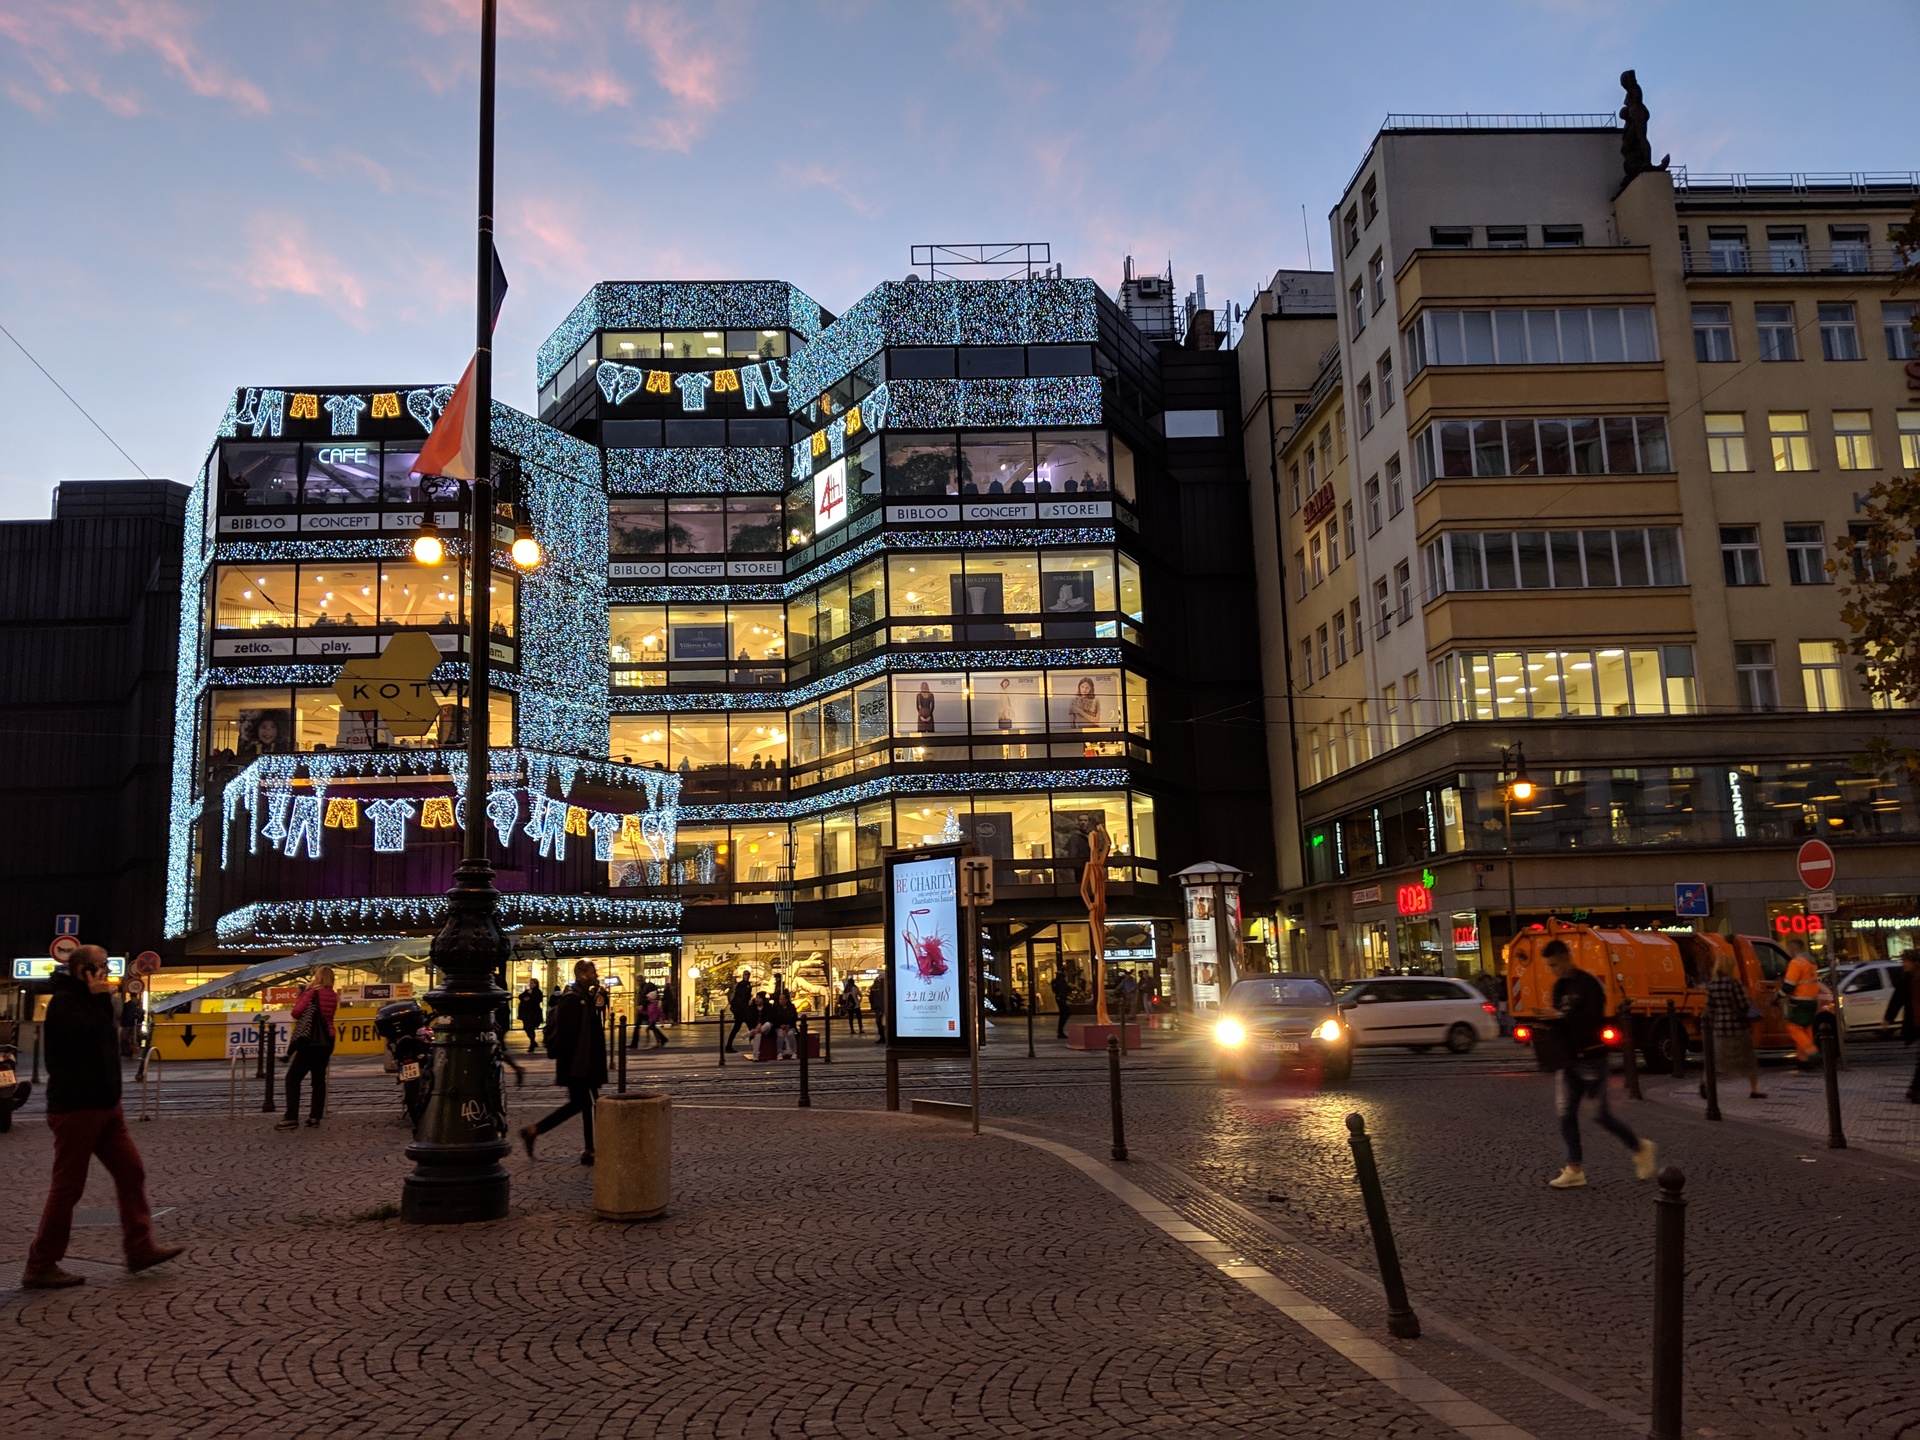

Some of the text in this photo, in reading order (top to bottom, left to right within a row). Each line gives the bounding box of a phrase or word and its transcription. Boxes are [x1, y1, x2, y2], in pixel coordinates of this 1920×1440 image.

[318, 448, 367, 464] CAFE
[897, 504, 1099, 519] BIBLOO CONCEPT STORE!
[231, 514, 446, 529] BIBLOO CONCEPT STOE!
[824, 535, 839, 550] JUST
[613, 563, 777, 575] BIBLOO CONCEPT STORE!
[234, 640, 352, 654] zetko. play.
[1728, 772, 1747, 837] PIZZA
[1426, 790, 1436, 852] PIZZA
[1374, 808, 1383, 865] PASTA
[1335, 822, 1344, 874] GRILL
[896, 873, 954, 893] BE CHARITY
[1398, 884, 1432, 914] coa
[1775, 914, 1823, 935] coa
[1851, 919, 1876, 929] asian
[690, 950, 730, 971] PRICE
[275, 990, 291, 1000] pet
[230, 1026, 287, 1044] albt
[229, 1046, 287, 1056] SUPERMAKET
